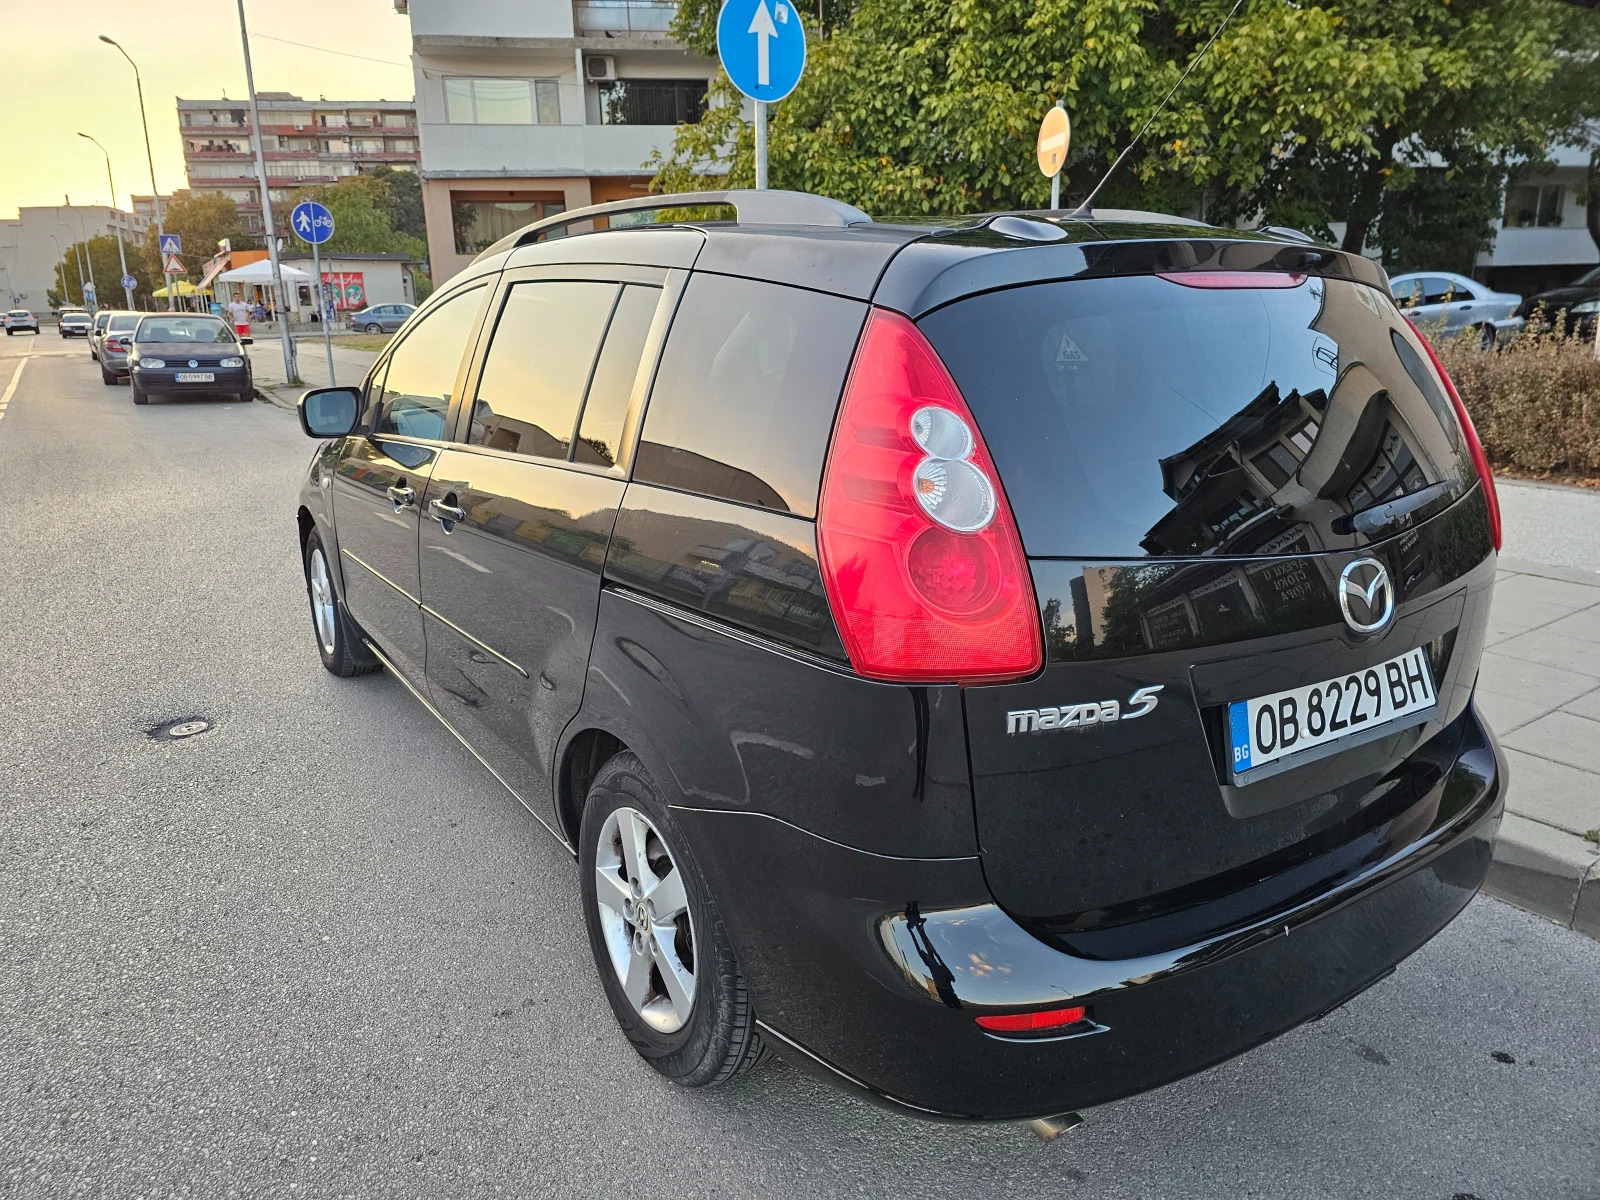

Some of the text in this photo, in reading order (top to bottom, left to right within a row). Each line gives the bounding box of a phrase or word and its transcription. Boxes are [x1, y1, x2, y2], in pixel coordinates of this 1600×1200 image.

[1063, 350, 1081, 360] GAS
[1121, 684, 1165, 720] 5
[1256, 653, 1430, 755] OB 8229 BH
[1234, 744, 1250, 763] BG
